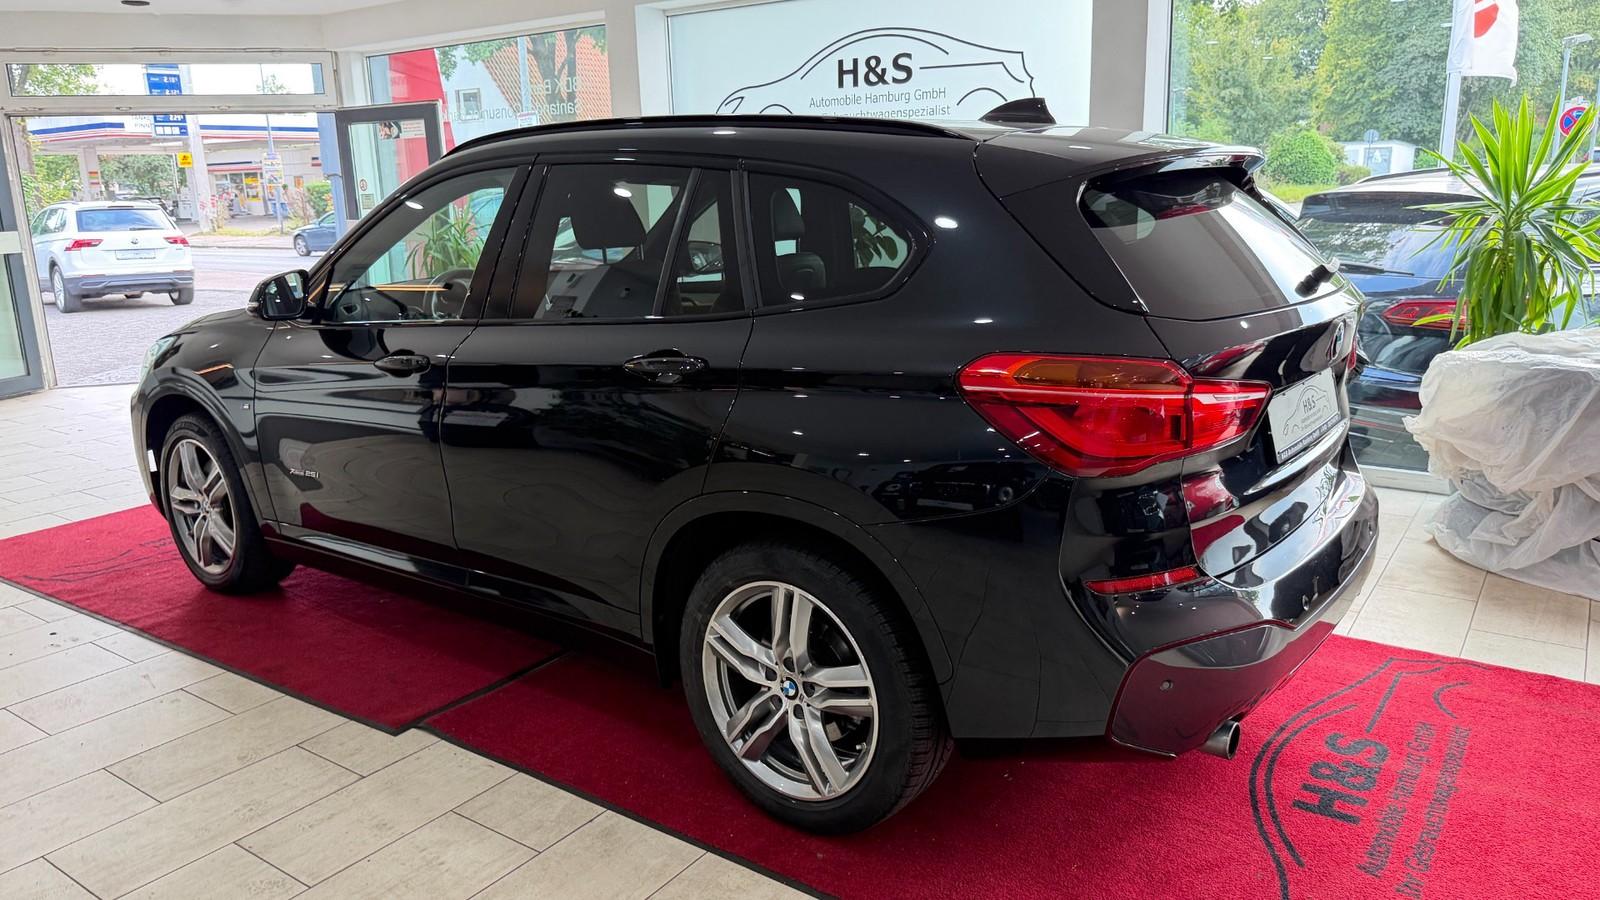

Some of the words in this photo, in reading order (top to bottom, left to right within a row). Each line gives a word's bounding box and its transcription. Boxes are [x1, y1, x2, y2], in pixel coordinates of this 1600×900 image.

[837, 52, 913, 89] H&S
[809, 93, 862, 108] Automobile
[865, 91, 911, 104] Hamburg
[913, 87, 946, 101] GmbH
[822, 105, 951, 119] uchtwagenspezialist
[1292, 733, 1389, 825] H&S
